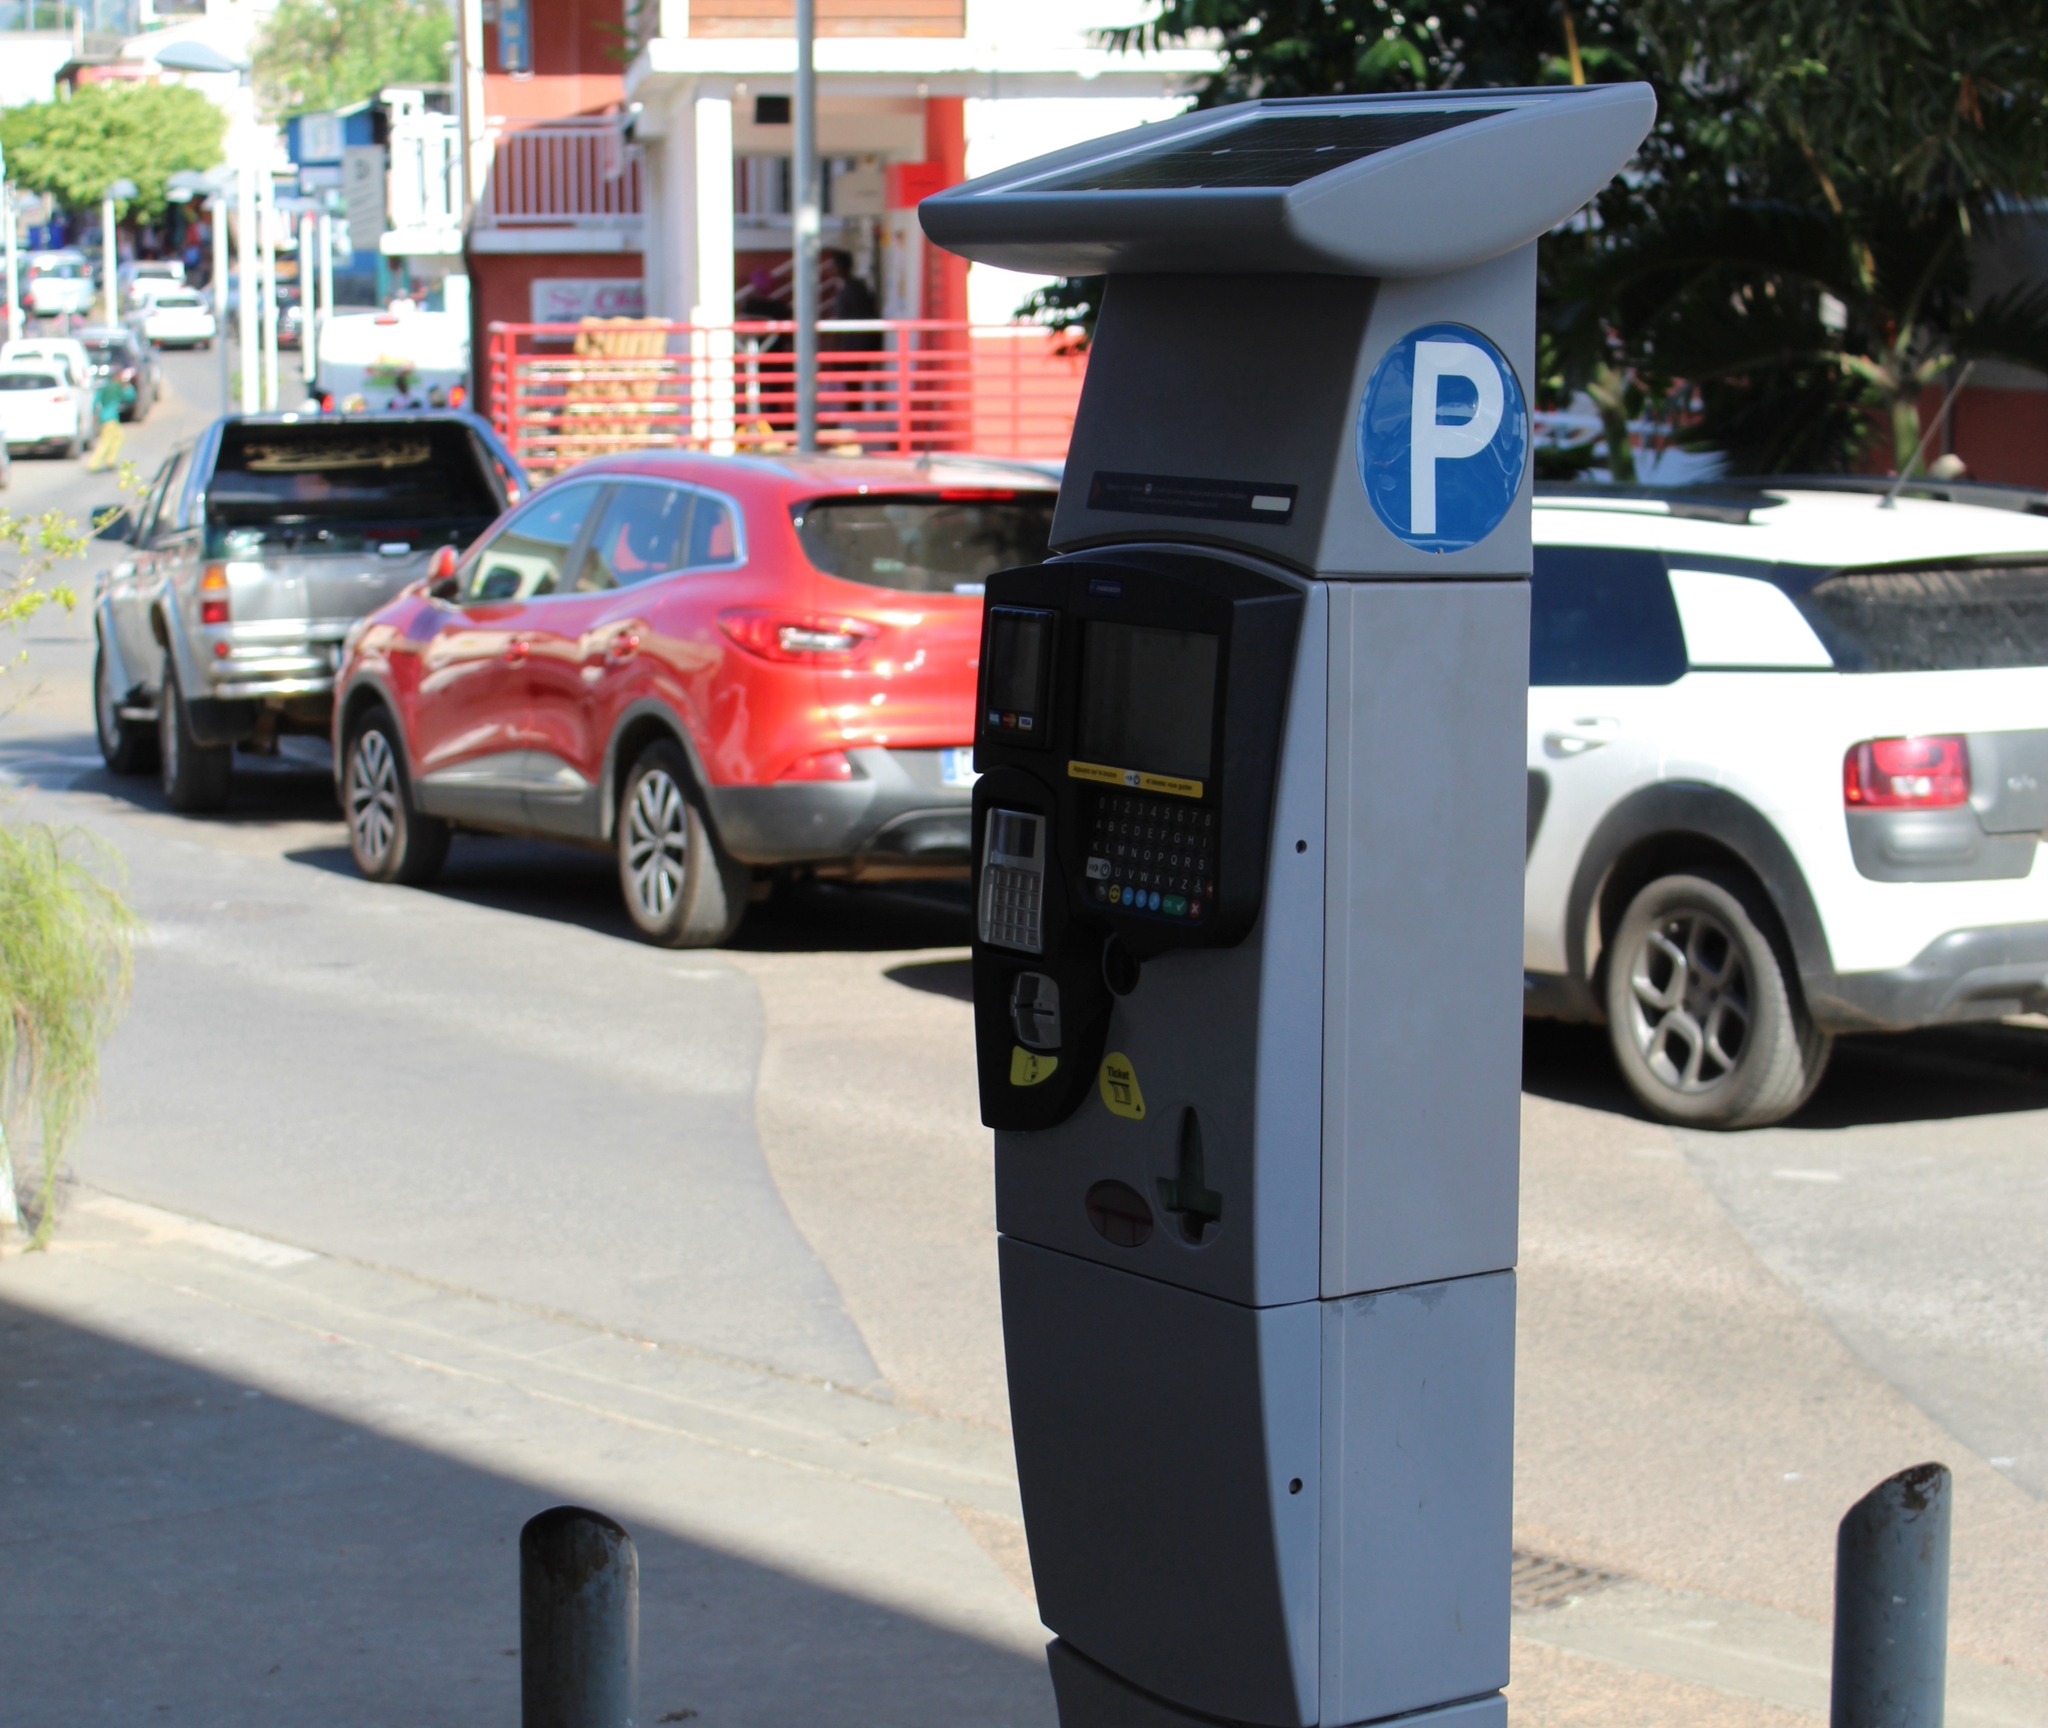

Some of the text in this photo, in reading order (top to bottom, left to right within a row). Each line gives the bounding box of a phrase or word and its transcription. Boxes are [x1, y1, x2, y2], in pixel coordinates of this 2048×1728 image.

[1411, 341, 1504, 534] P
[1112, 799, 1117, 811] 1
[1124, 801, 1131, 813] 2
[1138, 804, 1144, 815] 3
[1150, 806, 1157, 817] 4
[1164, 808, 1170, 820] 5
[1177, 810, 1184, 822] 6
[1191, 811, 1198, 823] 7
[1204, 814, 1211, 827] 8
[1095, 819, 1102, 829] A
[1108, 821, 1114, 832] B
[1121, 823, 1128, 834] C
[1134, 826, 1141, 836] D
[1147, 828, 1153, 839] E
[1161, 830, 1167, 840] F
[1174, 833, 1181, 843] G
[1188, 835, 1195, 845] H
[1092, 841, 1205, 870] K L M N O P Q R S
[1115, 867, 1188, 890] U V W X Y Z
[1107, 1066, 1130, 1081] Ticket
